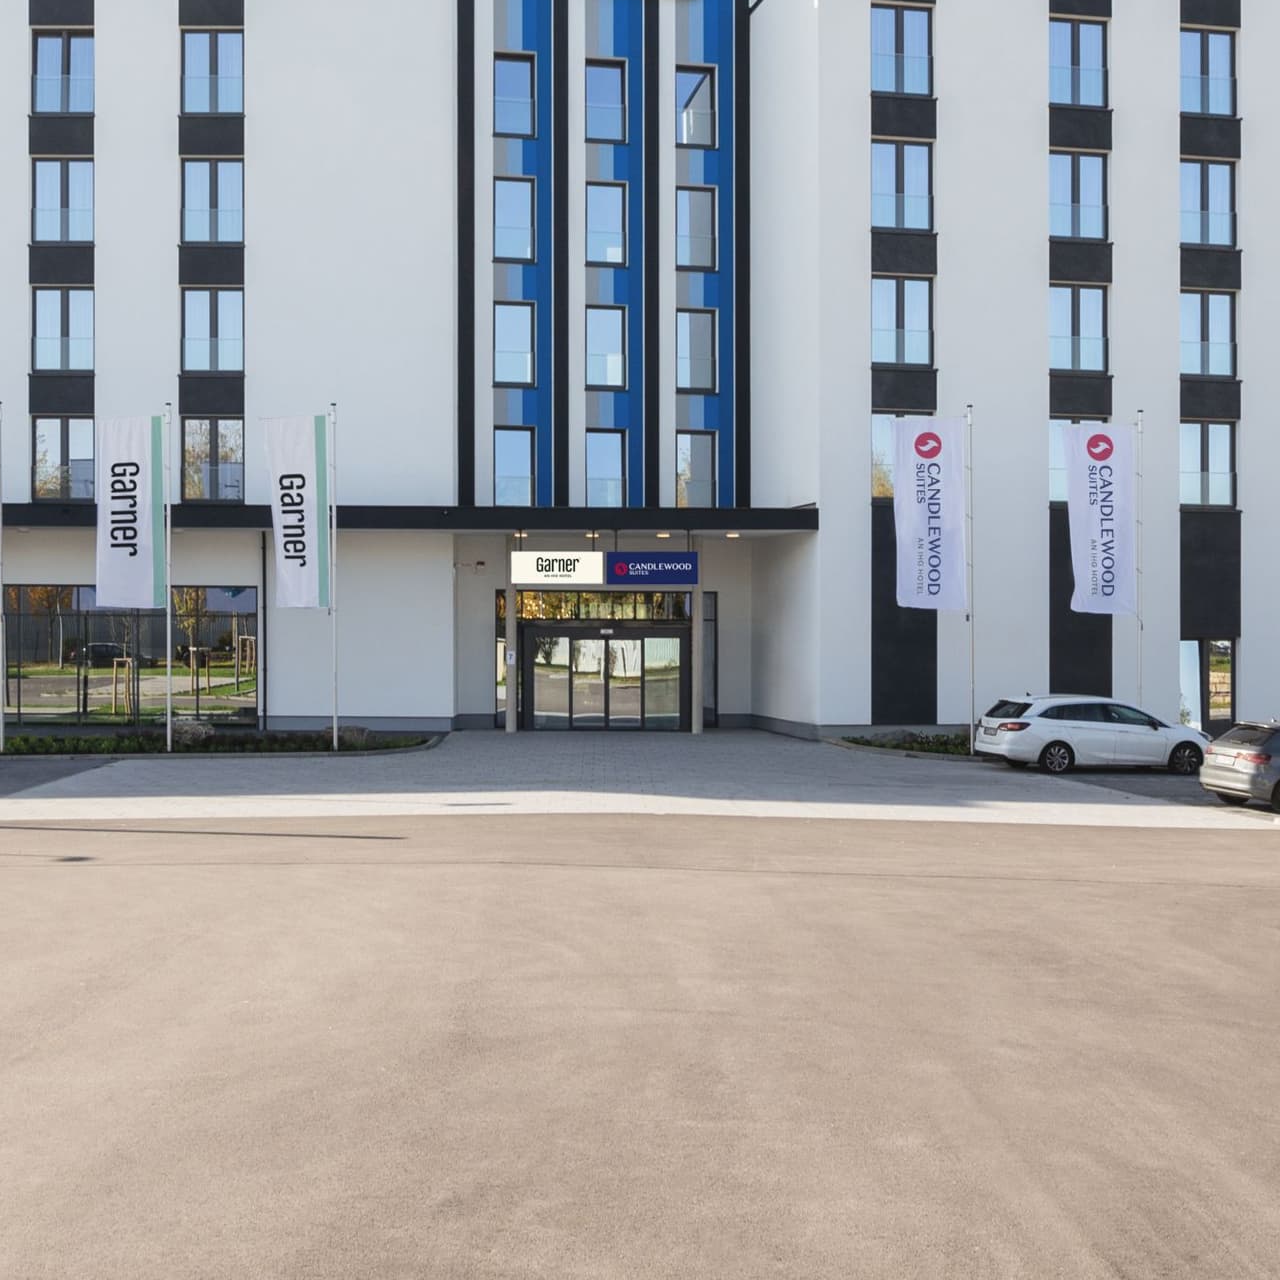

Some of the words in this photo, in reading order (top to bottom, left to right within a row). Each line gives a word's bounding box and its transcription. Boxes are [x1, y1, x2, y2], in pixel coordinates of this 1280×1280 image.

[915, 463, 926, 505] SUITES
[1088, 465, 1099, 506] SUITES
[110, 462, 140, 557] Garner
[278, 473, 307, 568] Garner
[917, 537, 924, 549] AN
[927, 462, 942, 597] CANDLEWOOD
[1090, 539, 1098, 551] AN
[1098, 465, 1115, 598] CANDLEWOOD
[536, 556, 580, 573] Garner
[628, 562, 692, 571] CANDLEWOOD
[1090, 553, 1098, 568] IHG
[1091, 570, 1099, 596] HOTEL
